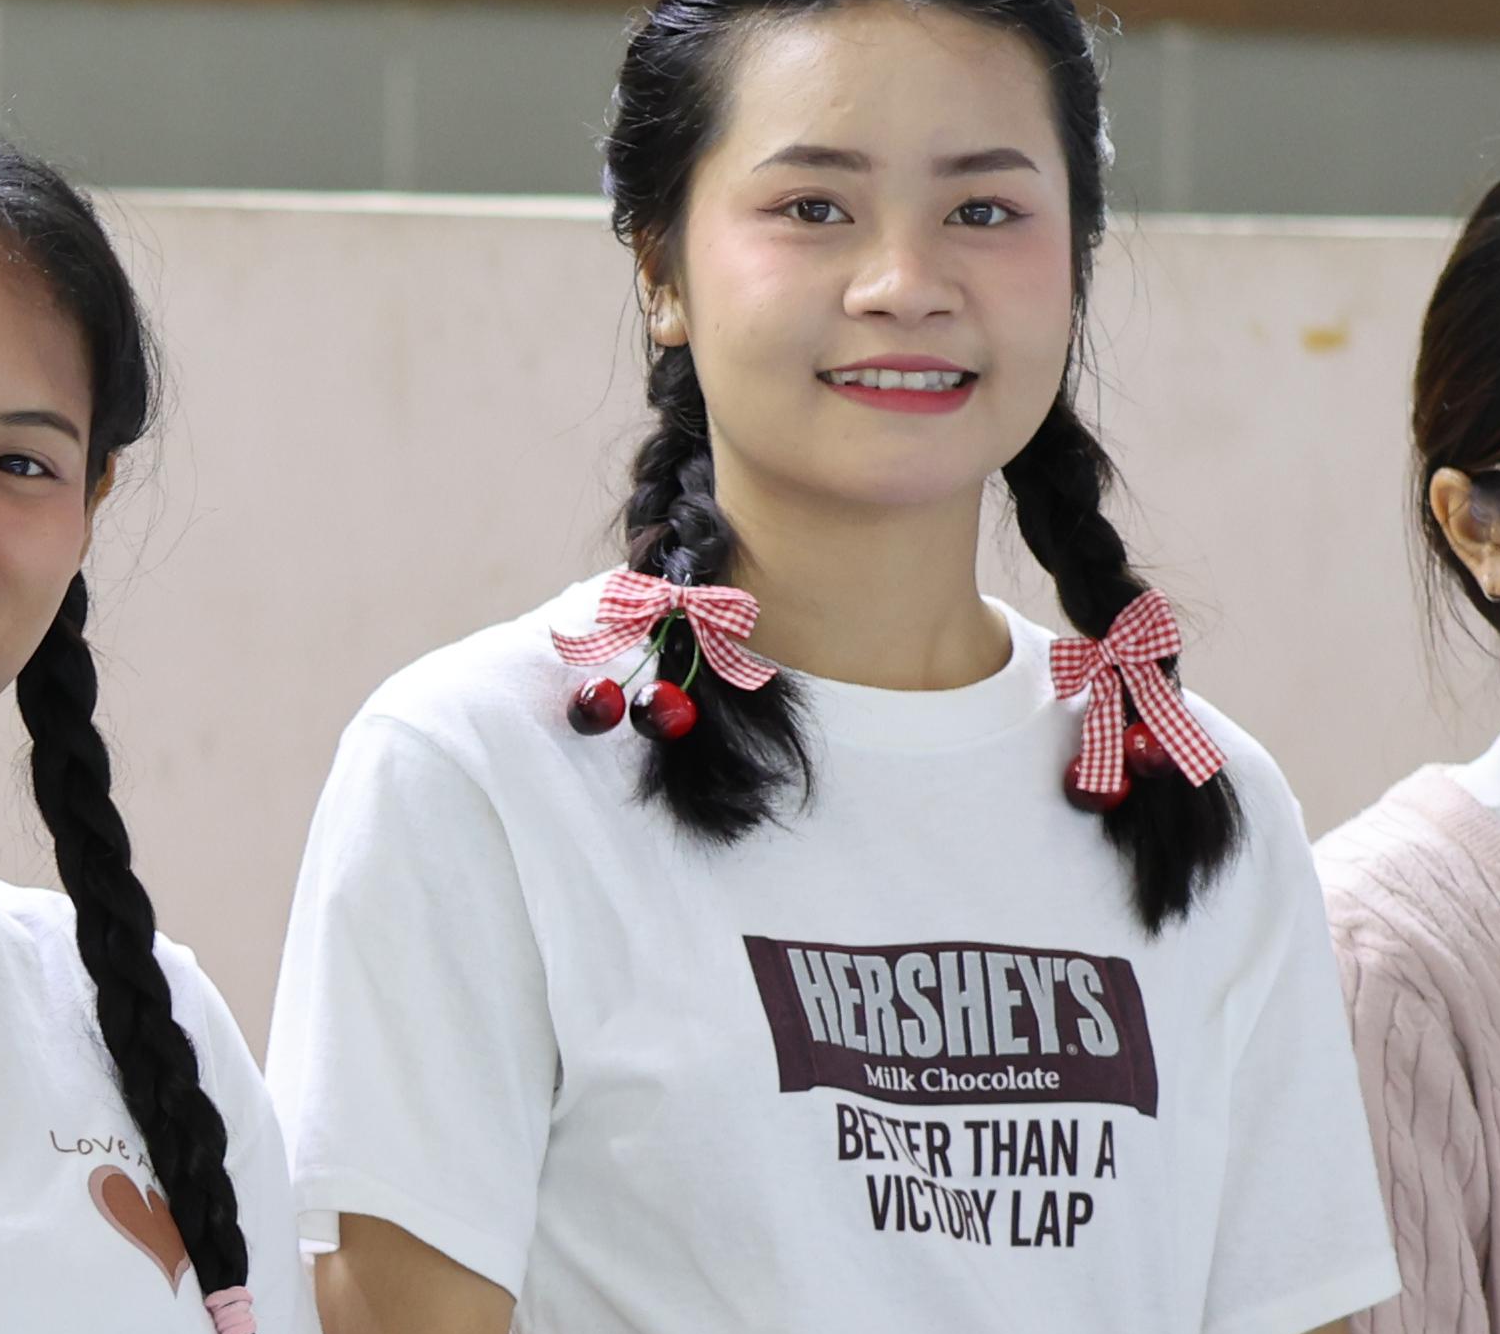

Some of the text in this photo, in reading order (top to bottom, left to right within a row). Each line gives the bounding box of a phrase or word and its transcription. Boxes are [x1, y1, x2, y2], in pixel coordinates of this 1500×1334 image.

[786, 947, 1120, 1059] HERSHEY'S
[864, 1064, 1060, 1092] Milk Chocolate
[49, 1129, 130, 1161] Love
[837, 1103, 1117, 1179] BETTER THAN A
[866, 1174, 1094, 1248] VICTORY LAP
